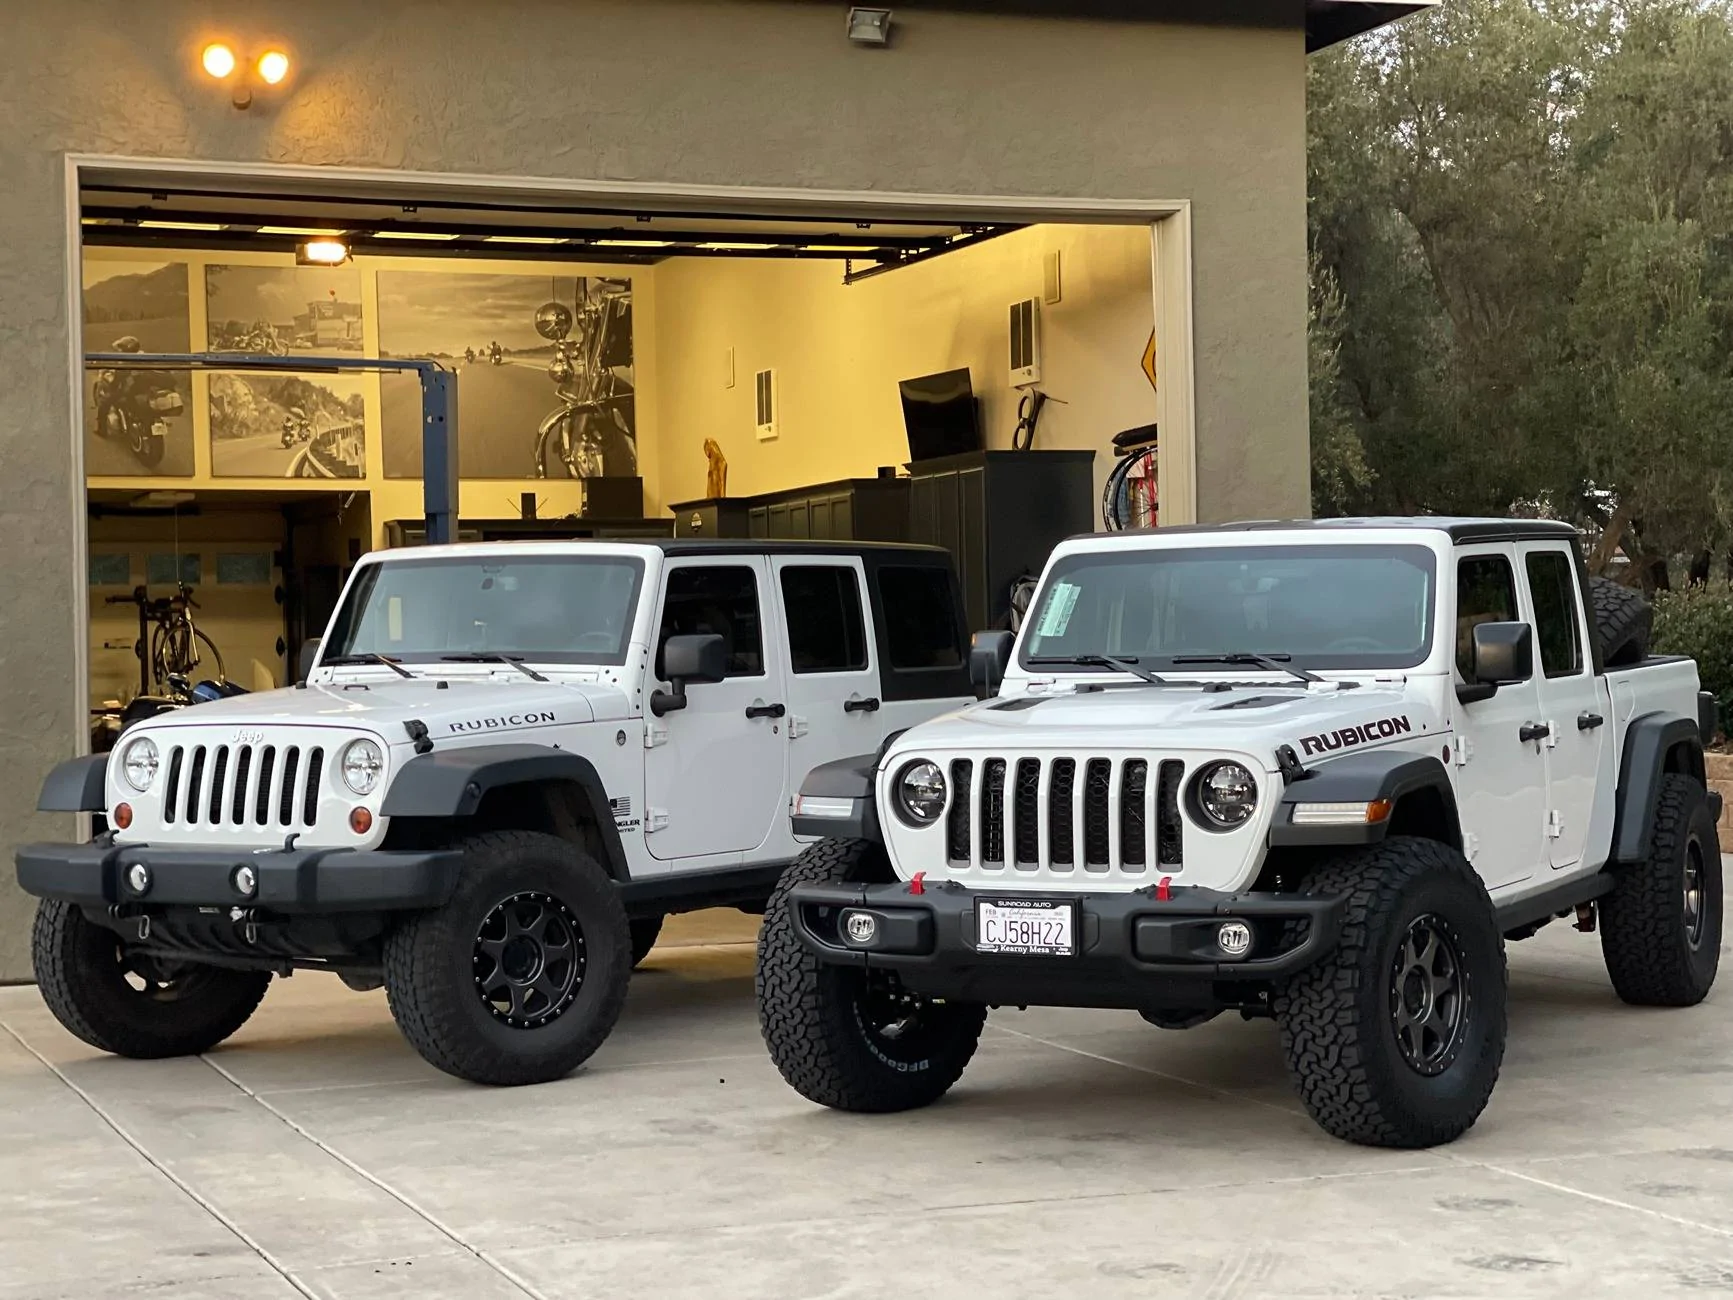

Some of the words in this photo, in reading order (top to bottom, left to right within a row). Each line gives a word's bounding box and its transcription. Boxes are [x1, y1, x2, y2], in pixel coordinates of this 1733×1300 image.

[449, 711, 556, 732] RUBICON
[233, 729, 265, 745] Jeep
[1299, 715, 1411, 756] RUBICON
[986, 919, 1065, 946] CJ58H22
[1000, 944, 1028, 954] Kearny
